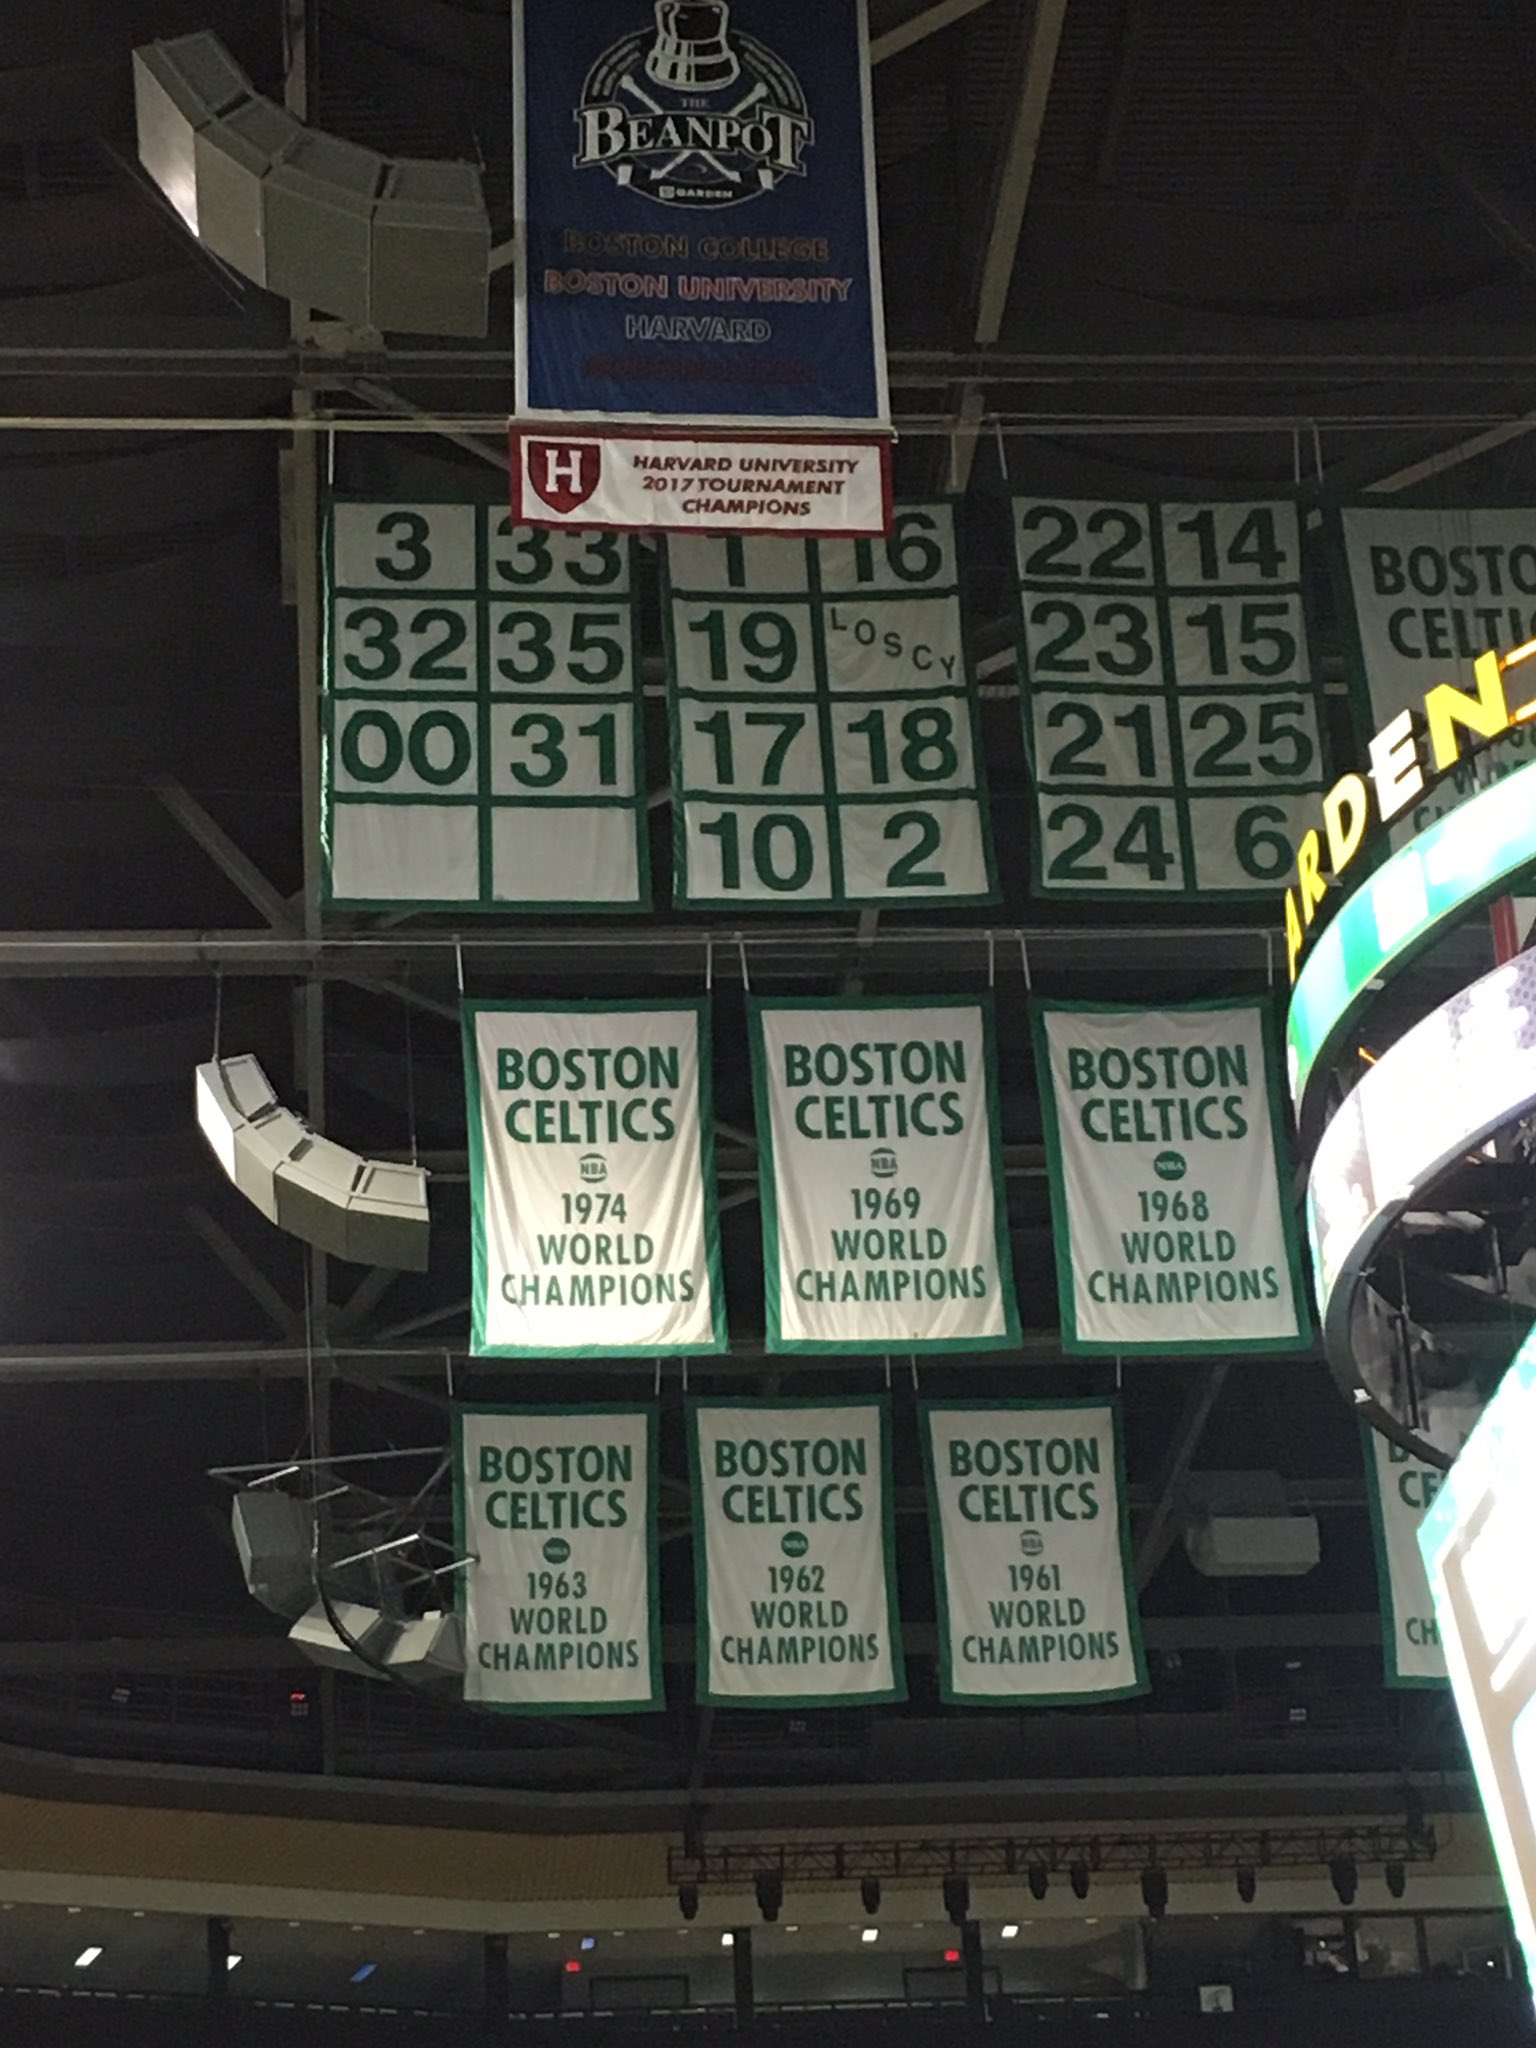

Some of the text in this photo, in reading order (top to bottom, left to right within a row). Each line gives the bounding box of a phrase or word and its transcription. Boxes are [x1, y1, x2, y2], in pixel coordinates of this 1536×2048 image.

[582, 106, 807, 168] BEANPOT
[564, 230, 829, 262] BOSTON COLLEGE
[544, 268, 853, 302] BOSTON UNIVERSITY
[625, 314, 771, 342] HARVARD
[545, 449, 583, 493] H
[633, 455, 858, 475] HARVARD UNIVERSITY
[642, 476, 845, 494] 2017 TOURNAMENT
[682, 498, 810, 516] CHAMPIONS
[375, 512, 432, 582] 3
[496, 528, 622, 585] 33
[852, 513, 941, 582] 16
[1022, 505, 1146, 579] 22
[1178, 508, 1287, 580] 14
[343, 607, 467, 680] 32
[498, 612, 624, 686] 35
[689, 609, 798, 683] 19
[831, 609, 955, 678] LOSCY
[1030, 600, 1154, 676] 23
[1186, 603, 1296, 676] 15
[341, 709, 471, 785] 00
[510, 712, 617, 787] 31
[694, 710, 805, 786] 17
[847, 706, 957, 784] 18
[1046, 703, 1156, 778] 21
[1190, 703, 1314, 777] 25
[1285, 650, 1508, 985] ARDEN
[700, 812, 813, 891] 10
[883, 811, 946, 887] 2
[1046, 803, 1174, 881] 24
[1234, 805, 1294, 880] 6
[497, 1046, 679, 1090] BOSTON
[784, 1040, 966, 1086] BOSTON
[1068, 1045, 1248, 1090] BOSTON
[505, 1097, 676, 1143] CELTICS
[794, 1092, 964, 1139] CELTICS
[1081, 1096, 1248, 1143] CELTICS
[580, 1162, 608, 1175] NBA
[871, 1157, 898, 1170] NBA
[1155, 1160, 1185, 1171] NBA
[561, 1193, 627, 1224] 1974
[851, 1188, 920, 1220] 1969
[1138, 1190, 1209, 1223] 1968
[537, 1233, 653, 1265] WORLD
[832, 1228, 947, 1261] WORLD
[1121, 1230, 1236, 1264] WORLD
[500, 1269, 694, 1307] CHAMPIONS
[797, 1266, 986, 1303] CHAMPIONS
[1089, 1266, 1279, 1305] CHAMPIONS
[479, 1445, 632, 1485] BOSTON
[715, 1439, 866, 1478] BOSTON
[949, 1438, 1100, 1478] BOSTON
[485, 1490, 627, 1529] CELTICS
[721, 1483, 863, 1524] CELTICS
[958, 1482, 1099, 1523] CELTICS
[528, 1572, 587, 1599] 1963
[768, 1565, 824, 1593] 1962
[1008, 1565, 1060, 1592] 1961
[509, 1607, 608, 1636] WORLD
[750, 1601, 848, 1628] WORLD
[989, 1598, 1085, 1628] WORLD
[477, 1641, 639, 1671] CHAMPIONS
[720, 1634, 878, 1666] CHAMPIONS
[961, 1631, 1119, 1664] CHAMPIONS
